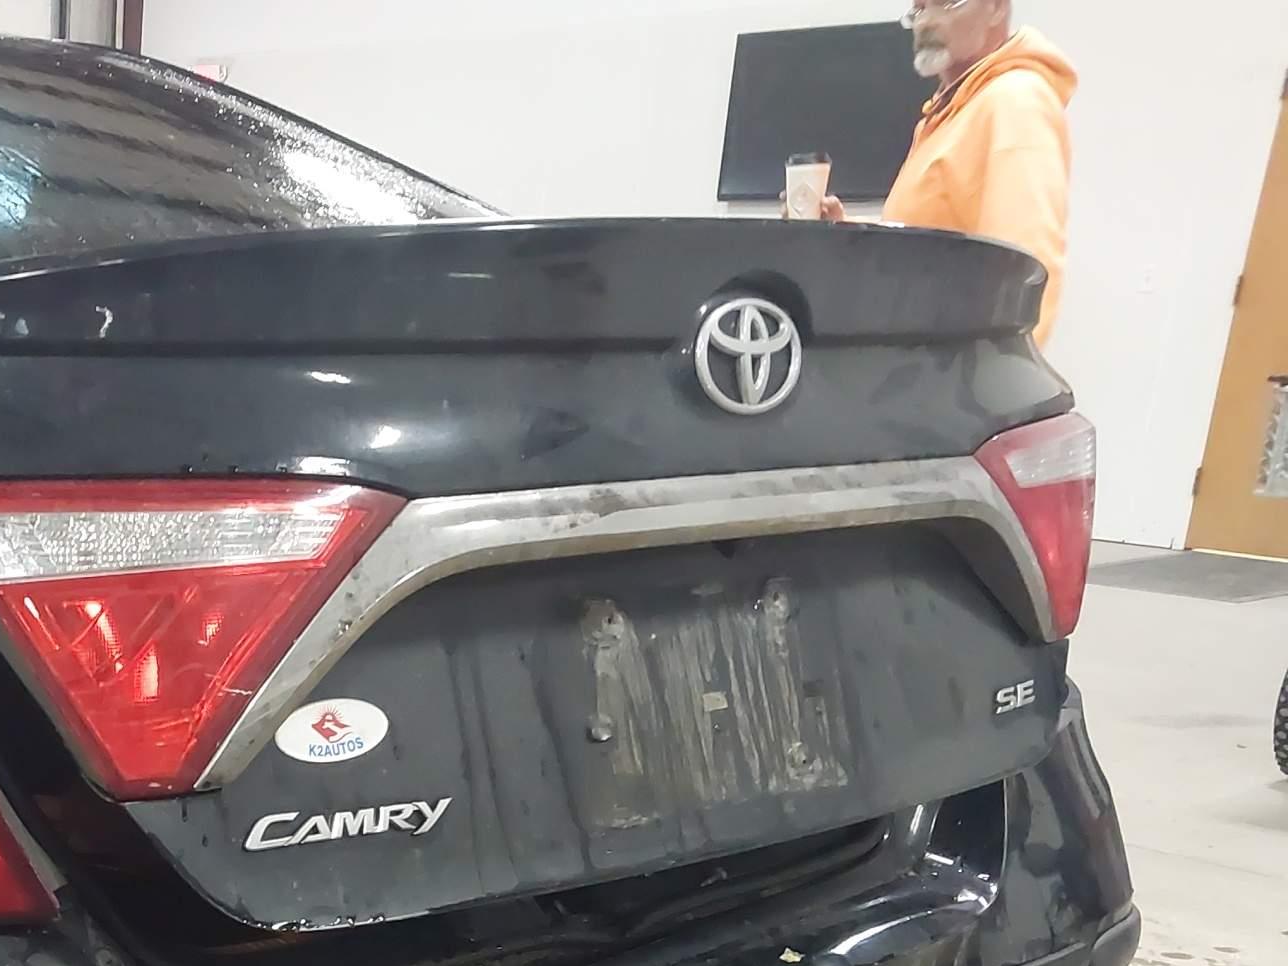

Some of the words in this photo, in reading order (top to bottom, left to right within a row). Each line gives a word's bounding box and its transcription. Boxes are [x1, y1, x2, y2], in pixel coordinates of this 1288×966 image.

[995, 679, 1036, 715] SE
[308, 737, 364, 757] K2AUTOS
[244, 797, 453, 851] CAMRY
